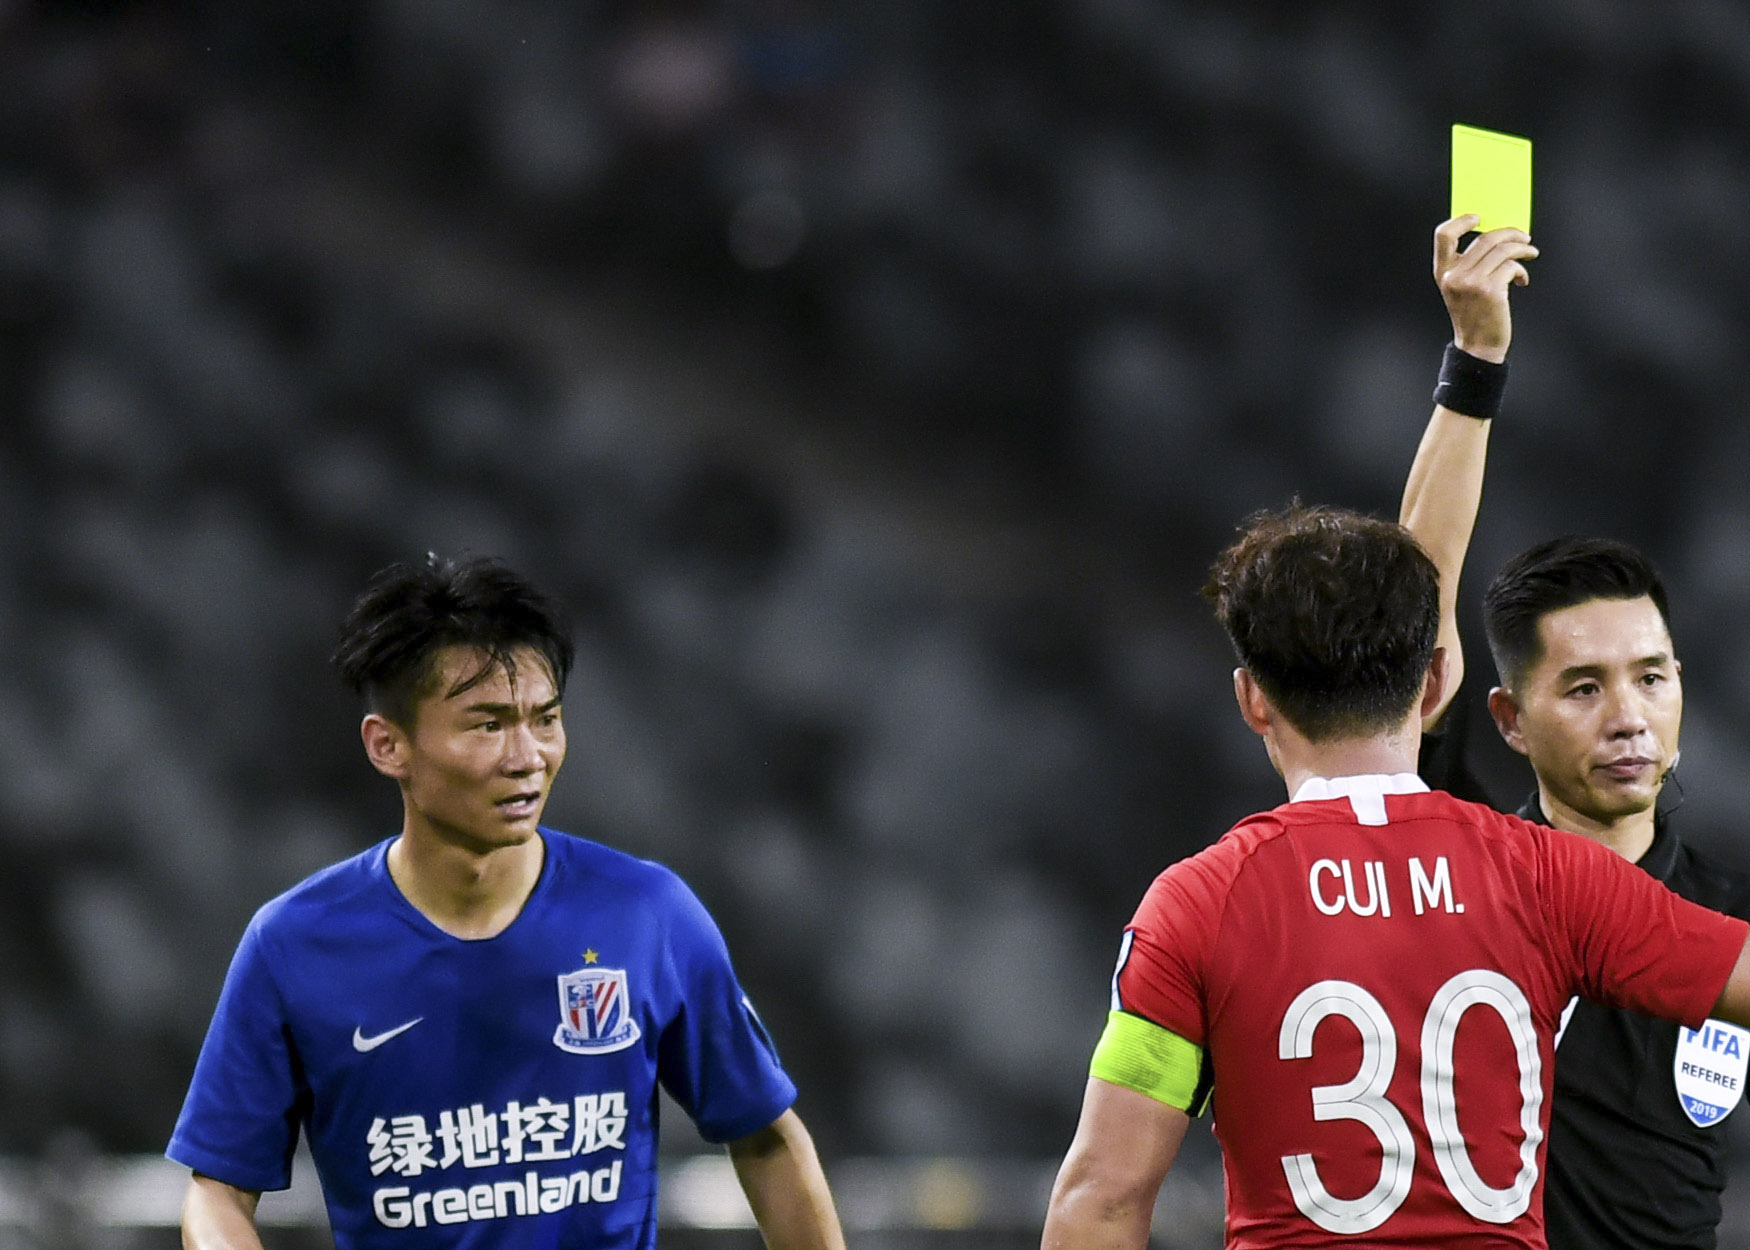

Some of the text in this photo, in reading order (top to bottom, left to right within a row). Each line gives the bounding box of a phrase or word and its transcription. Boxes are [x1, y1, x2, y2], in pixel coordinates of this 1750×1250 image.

[1309, 856, 1465, 918] CUI M.
[1686, 1025, 1741, 1060] FIFA
[1278, 968, 1544, 1235] 30
[1681, 1061, 1738, 1091] REFEREE
[366, 1091, 629, 1178] 绿地控股
[1689, 1100, 1718, 1119] 2019
[373, 1159, 623, 1229] Greenland
